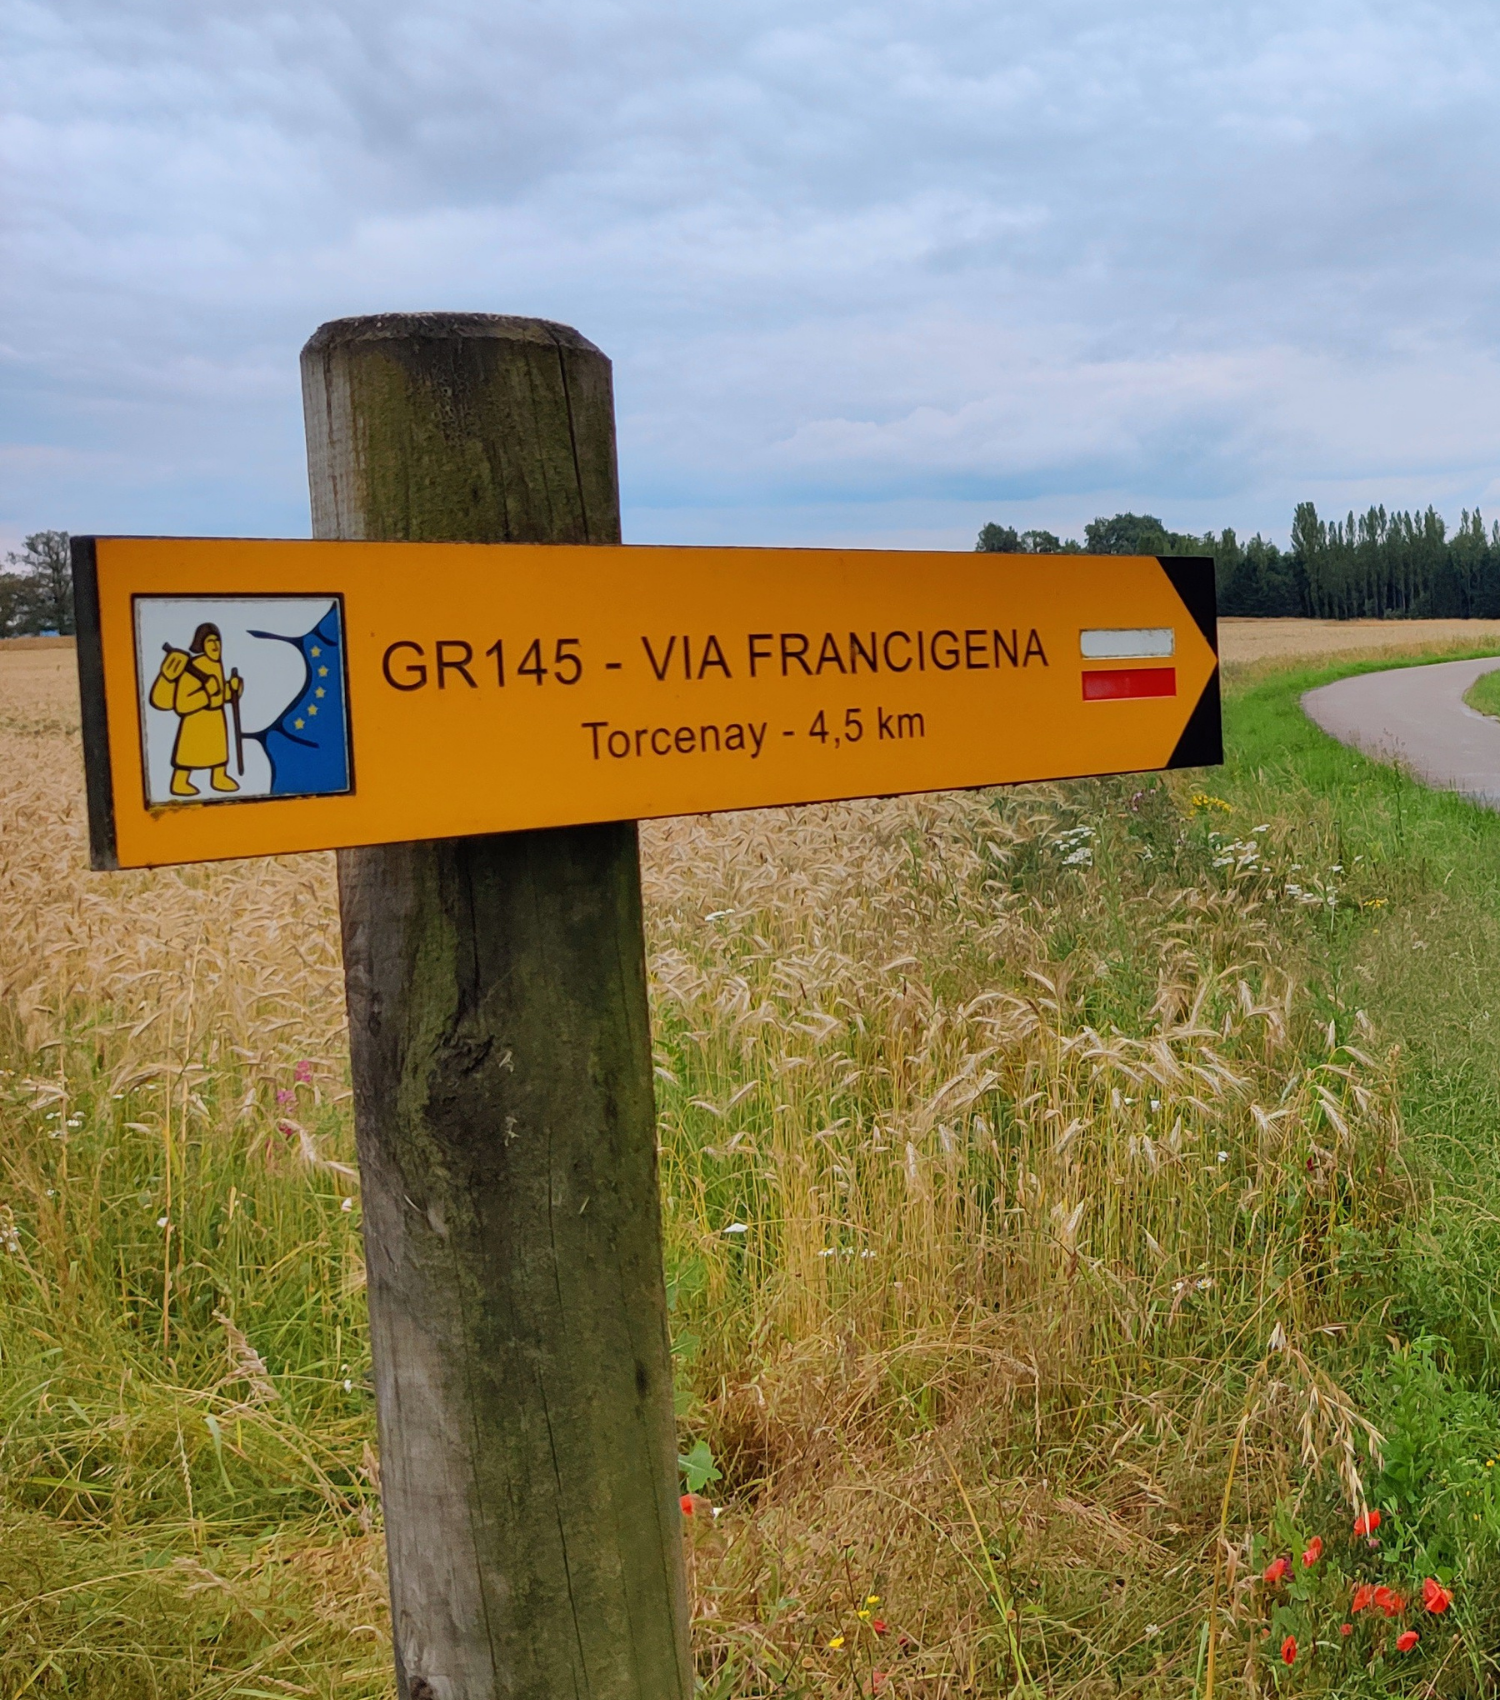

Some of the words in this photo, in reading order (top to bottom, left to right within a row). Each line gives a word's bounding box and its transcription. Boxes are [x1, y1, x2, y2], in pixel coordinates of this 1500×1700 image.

[382, 638, 583, 692] GR145
[641, 634, 732, 681] VIA
[748, 628, 1049, 678] FRANCIGENA
[581, 721, 768, 760] Torcenay
[808, 707, 864, 749] 4,5
[877, 706, 925, 740] km
